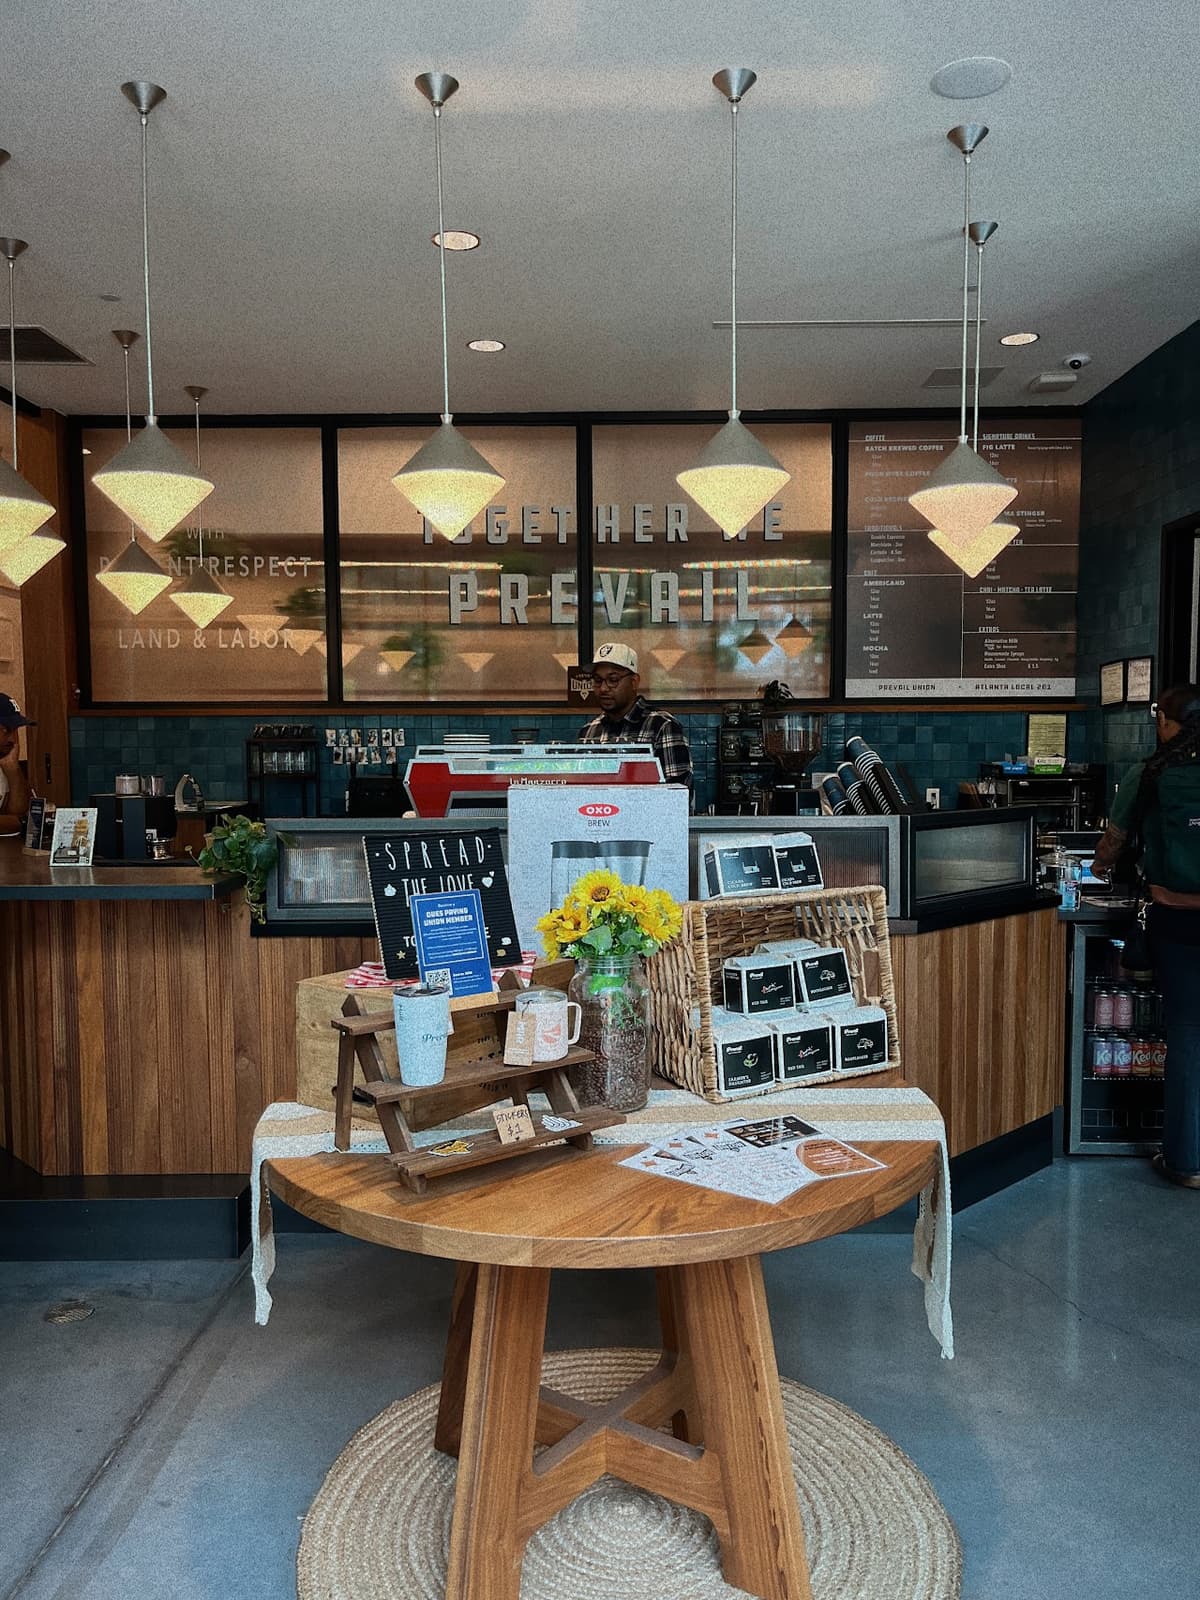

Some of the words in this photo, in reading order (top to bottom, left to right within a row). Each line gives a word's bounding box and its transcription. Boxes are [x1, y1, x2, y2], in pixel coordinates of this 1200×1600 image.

[208, 556, 312, 578] RESPECT
[449, 570, 760, 624] PREVAIL
[118, 628, 181, 649] LAND
[193, 628, 207, 649] &
[912, 683, 936, 691] UNION
[975, 683, 1009, 691] ATLANTA
[1010, 683, 1034, 691] LOCAL
[586, 806, 612, 815] OXO
[587, 819, 611, 827] BREW
[384, 836, 485, 871] SPREAD
[424, 918, 445, 926] UNION
[445, 914, 473, 923] MEMBER
[426, 910, 444, 918] DUES
[444, 907, 469, 916] PAYING
[496, 1109, 529, 1124] STICKERS
[507, 1122, 524, 1137] $1
